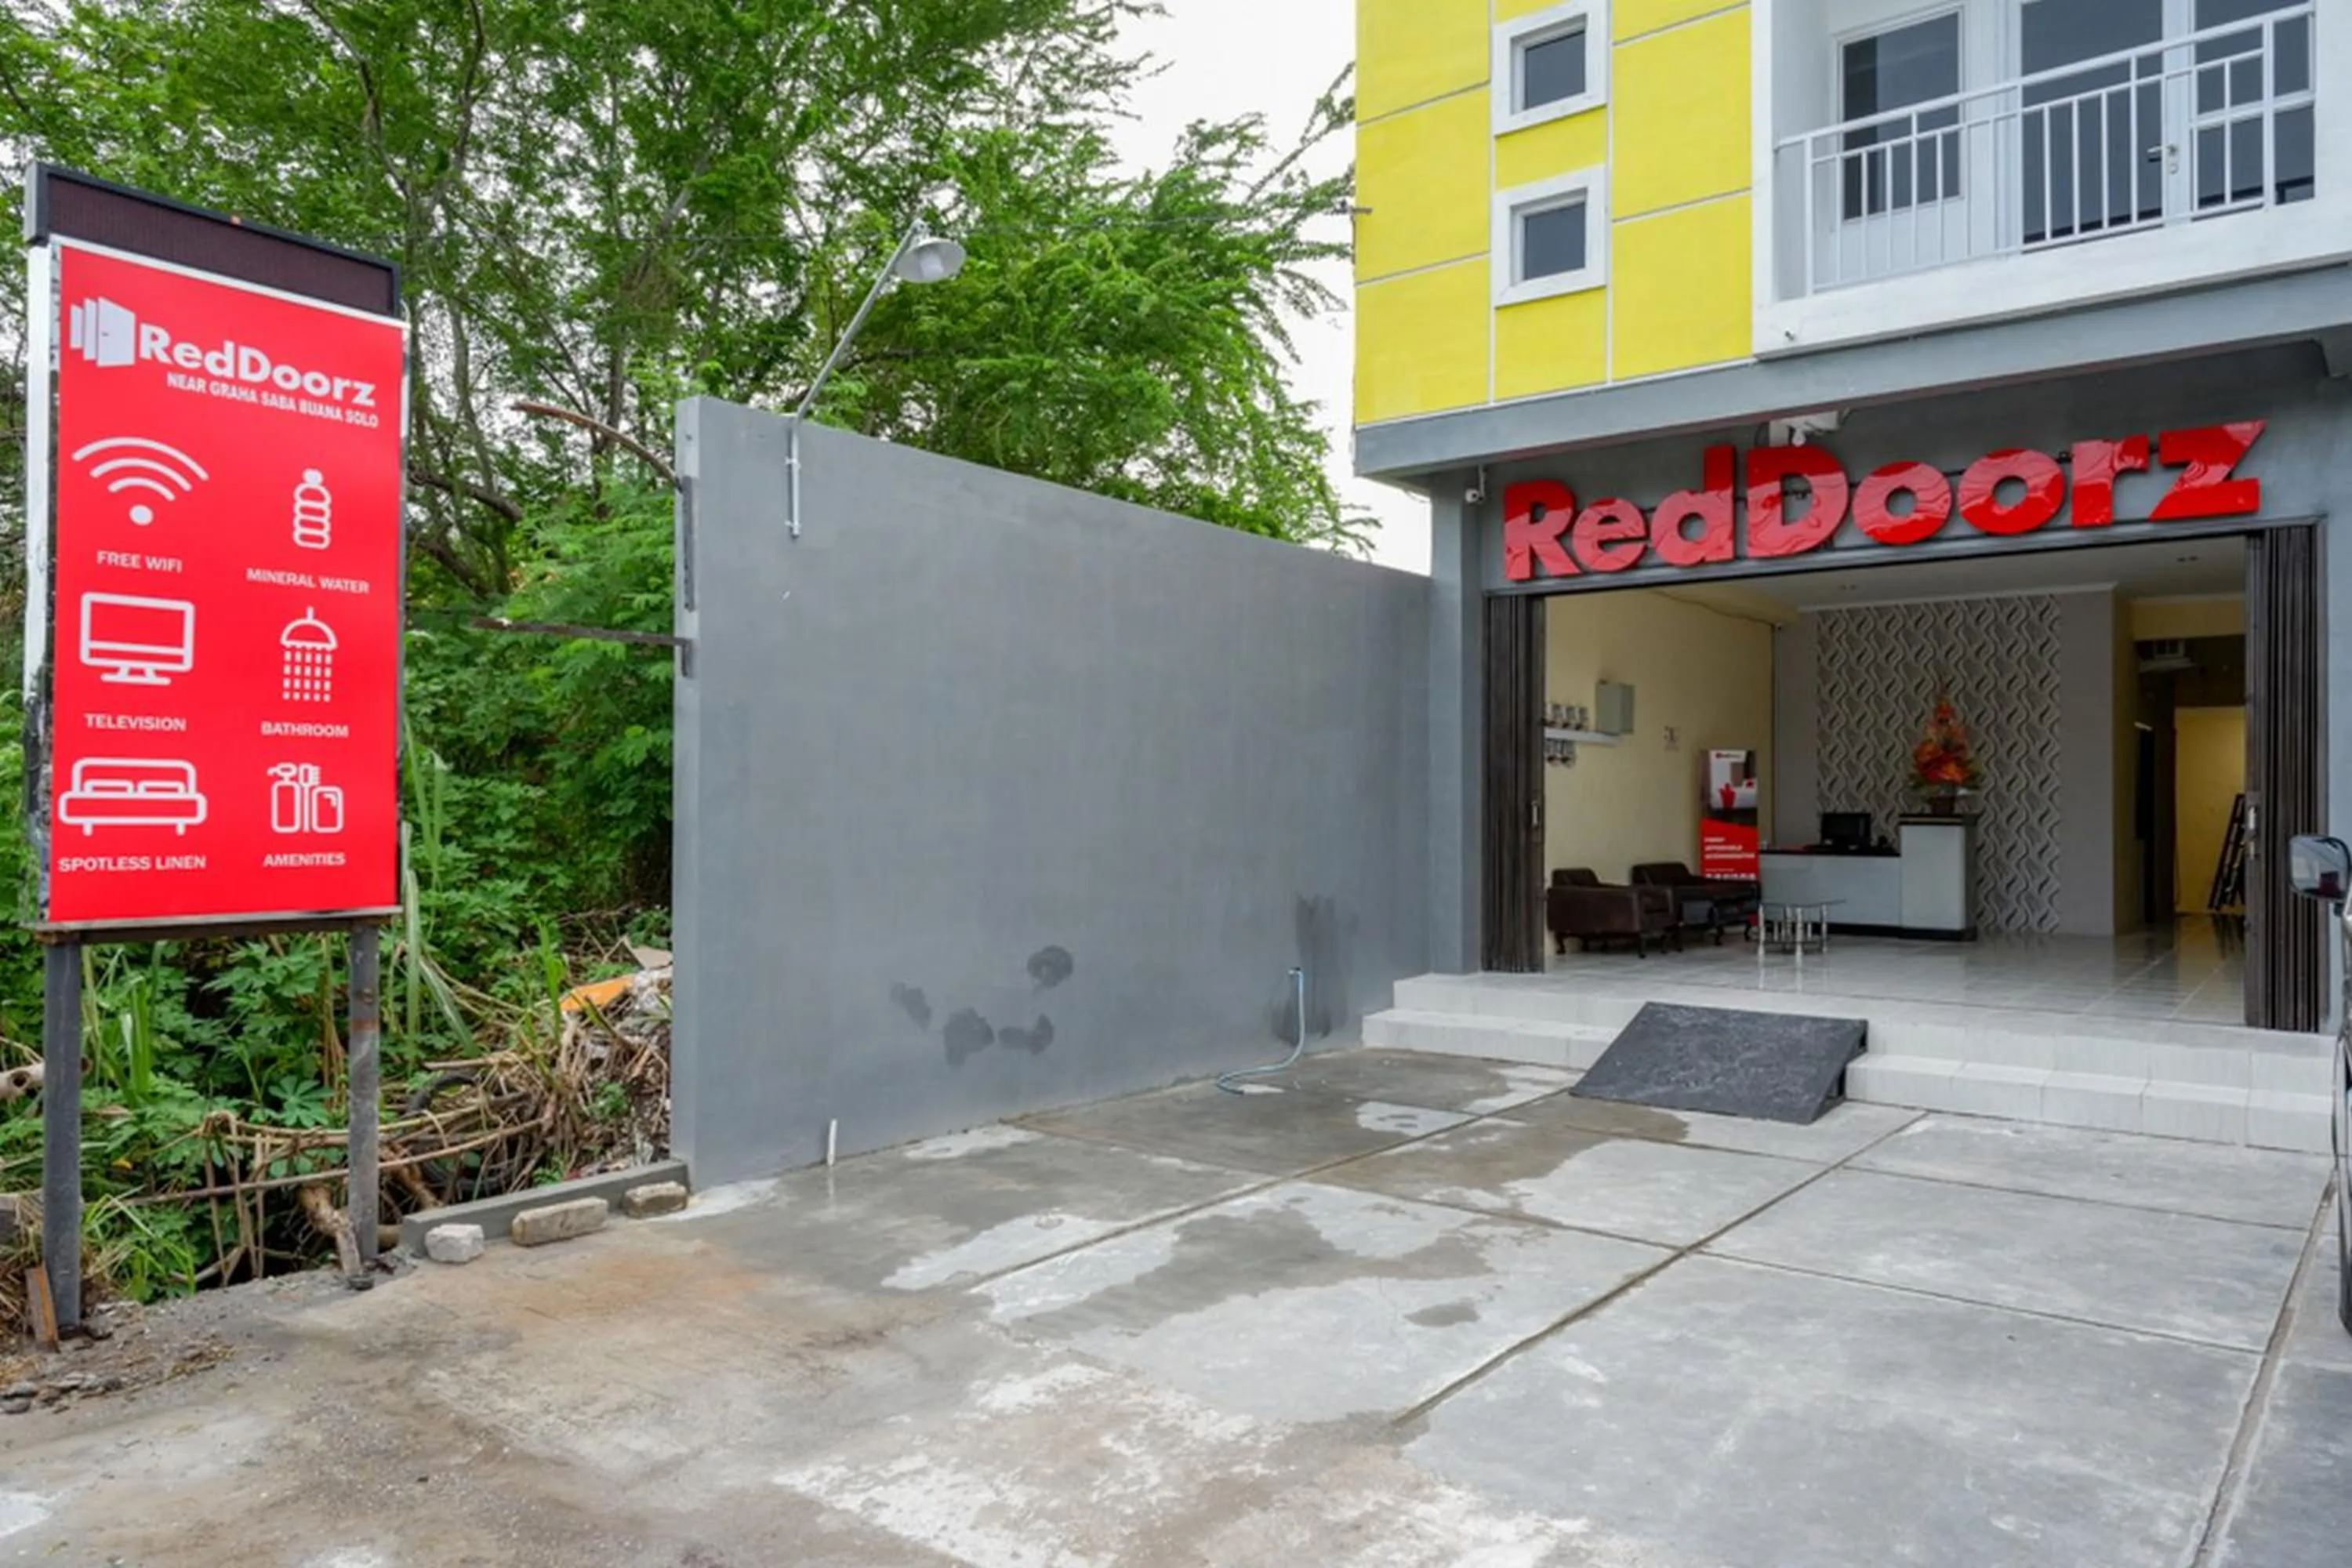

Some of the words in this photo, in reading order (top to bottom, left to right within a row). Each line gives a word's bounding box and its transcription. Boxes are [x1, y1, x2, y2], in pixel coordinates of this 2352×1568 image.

[140, 322, 376, 408] RedDoorz
[167, 372, 206, 393] NEAR
[261, 392, 297, 412] SABA
[299, 400, 343, 422] BUANA
[345, 410, 379, 429] SOLO
[1503, 419, 2267, 581] RedDoorz
[96, 550, 140, 569] FREE
[145, 555, 183, 573] WIFI
[246, 568, 316, 590] MINERAL
[319, 576, 369, 594] WATER
[84, 713, 187, 732] TELEVISION
[260, 720, 350, 738] BATHROOM
[58, 856, 152, 873] SPOTLESS
[155, 855, 207, 871] LINEN
[263, 852, 347, 867] AMENITIES
